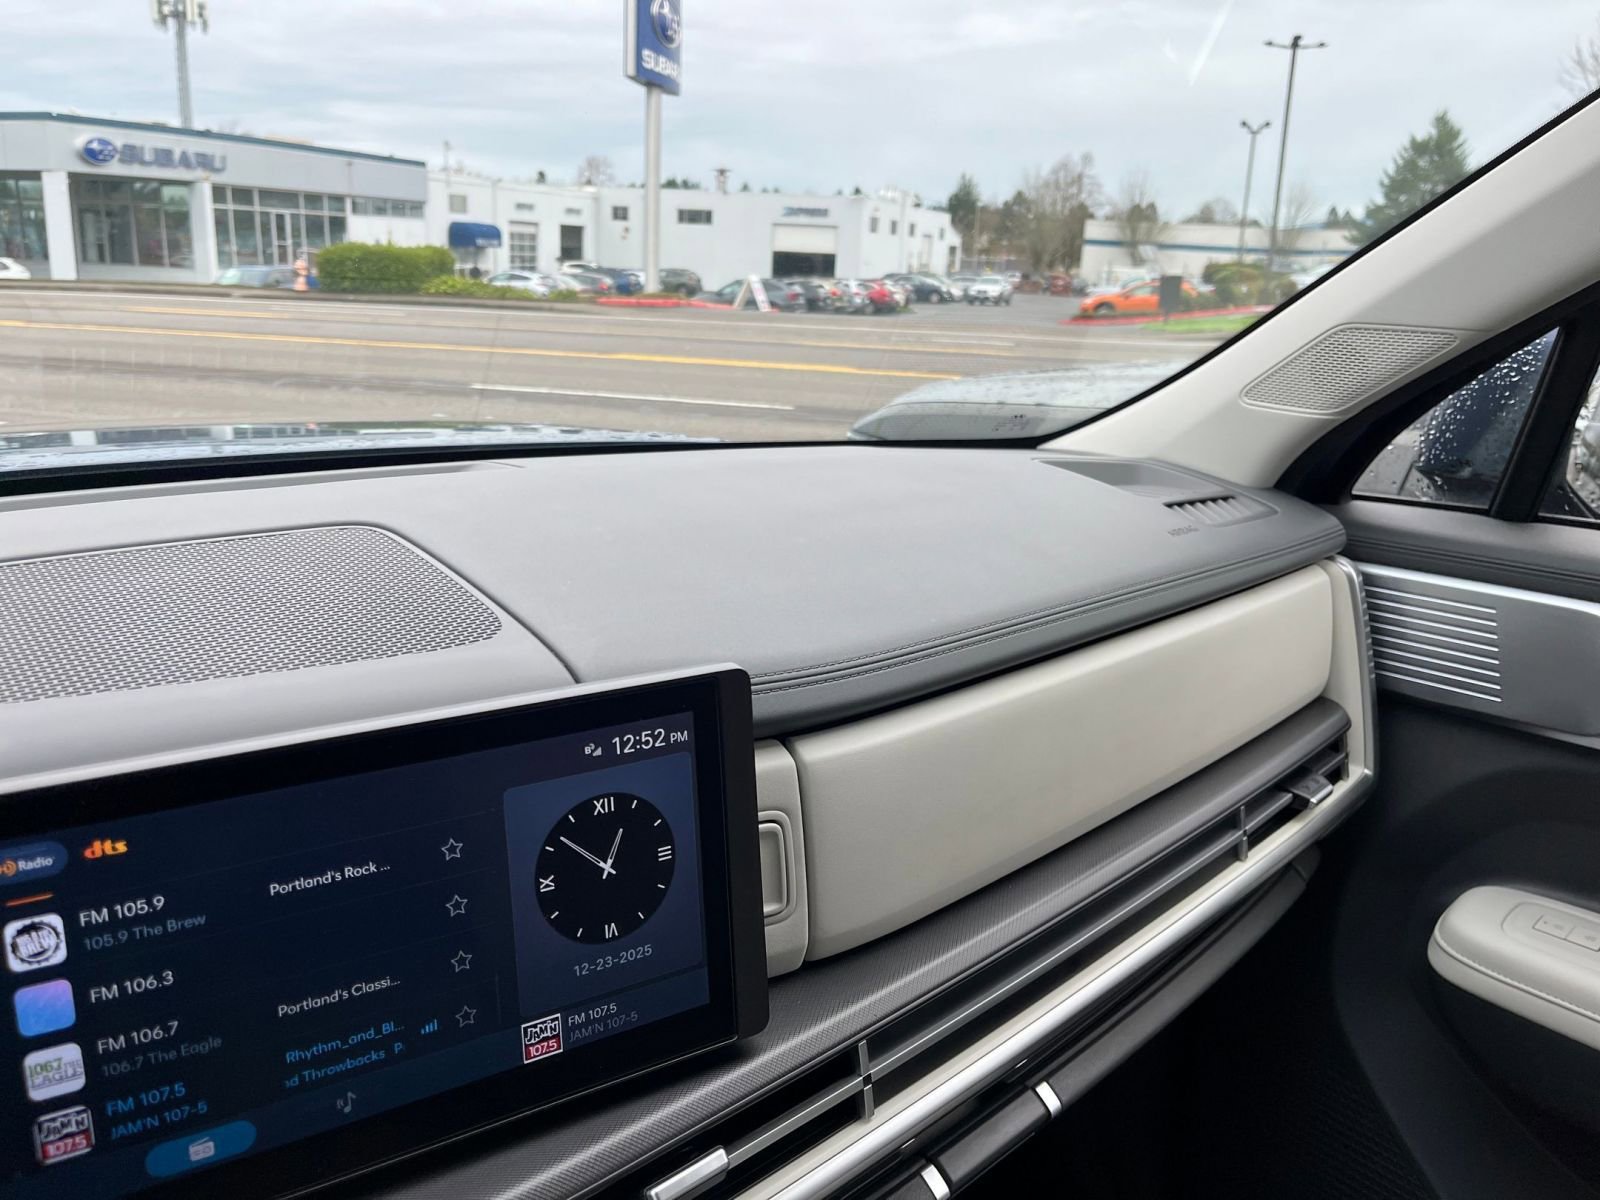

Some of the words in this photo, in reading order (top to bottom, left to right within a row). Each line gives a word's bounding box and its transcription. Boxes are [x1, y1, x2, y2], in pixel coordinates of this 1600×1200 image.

[119, 144, 227, 173] SUBARU
[611, 728, 666, 755] 12:52
[670, 730, 688, 743] PM
[17, 857, 53, 872] Radio
[83, 839, 128, 859] dts
[270, 871, 342, 896] Portland's
[79, 908, 109, 927] FM
[114, 896, 165, 919] 105.9
[84, 930, 128, 951] 105.9
[132, 925, 163, 939] The
[167, 915, 206, 932] Brew
[573, 944, 653, 977] 12-23-2025
[90, 984, 119, 1003] FM
[124, 971, 174, 994] 106.3
[278, 989, 349, 1017] Portland's
[568, 1013, 586, 1026] FM
[588, 1003, 617, 1020] 107.5
[97, 1034, 126, 1055] FM
[131, 1020, 178, 1045] 106.7
[569, 1023, 604, 1042] JAM'N
[607, 1011, 638, 1029] 107-5
[102, 1056, 144, 1076] 106.7
[147, 1050, 177, 1064] The
[181, 1036, 222, 1056] Eagle
[529, 1040, 557, 1057] 107.5
[302, 1050, 385, 1081] Throwbacks
[106, 1097, 135, 1116] FM
[140, 1082, 186, 1106] 107.5
[111, 1115, 160, 1139] JAM'N
[164, 1101, 208, 1122] 107-5
